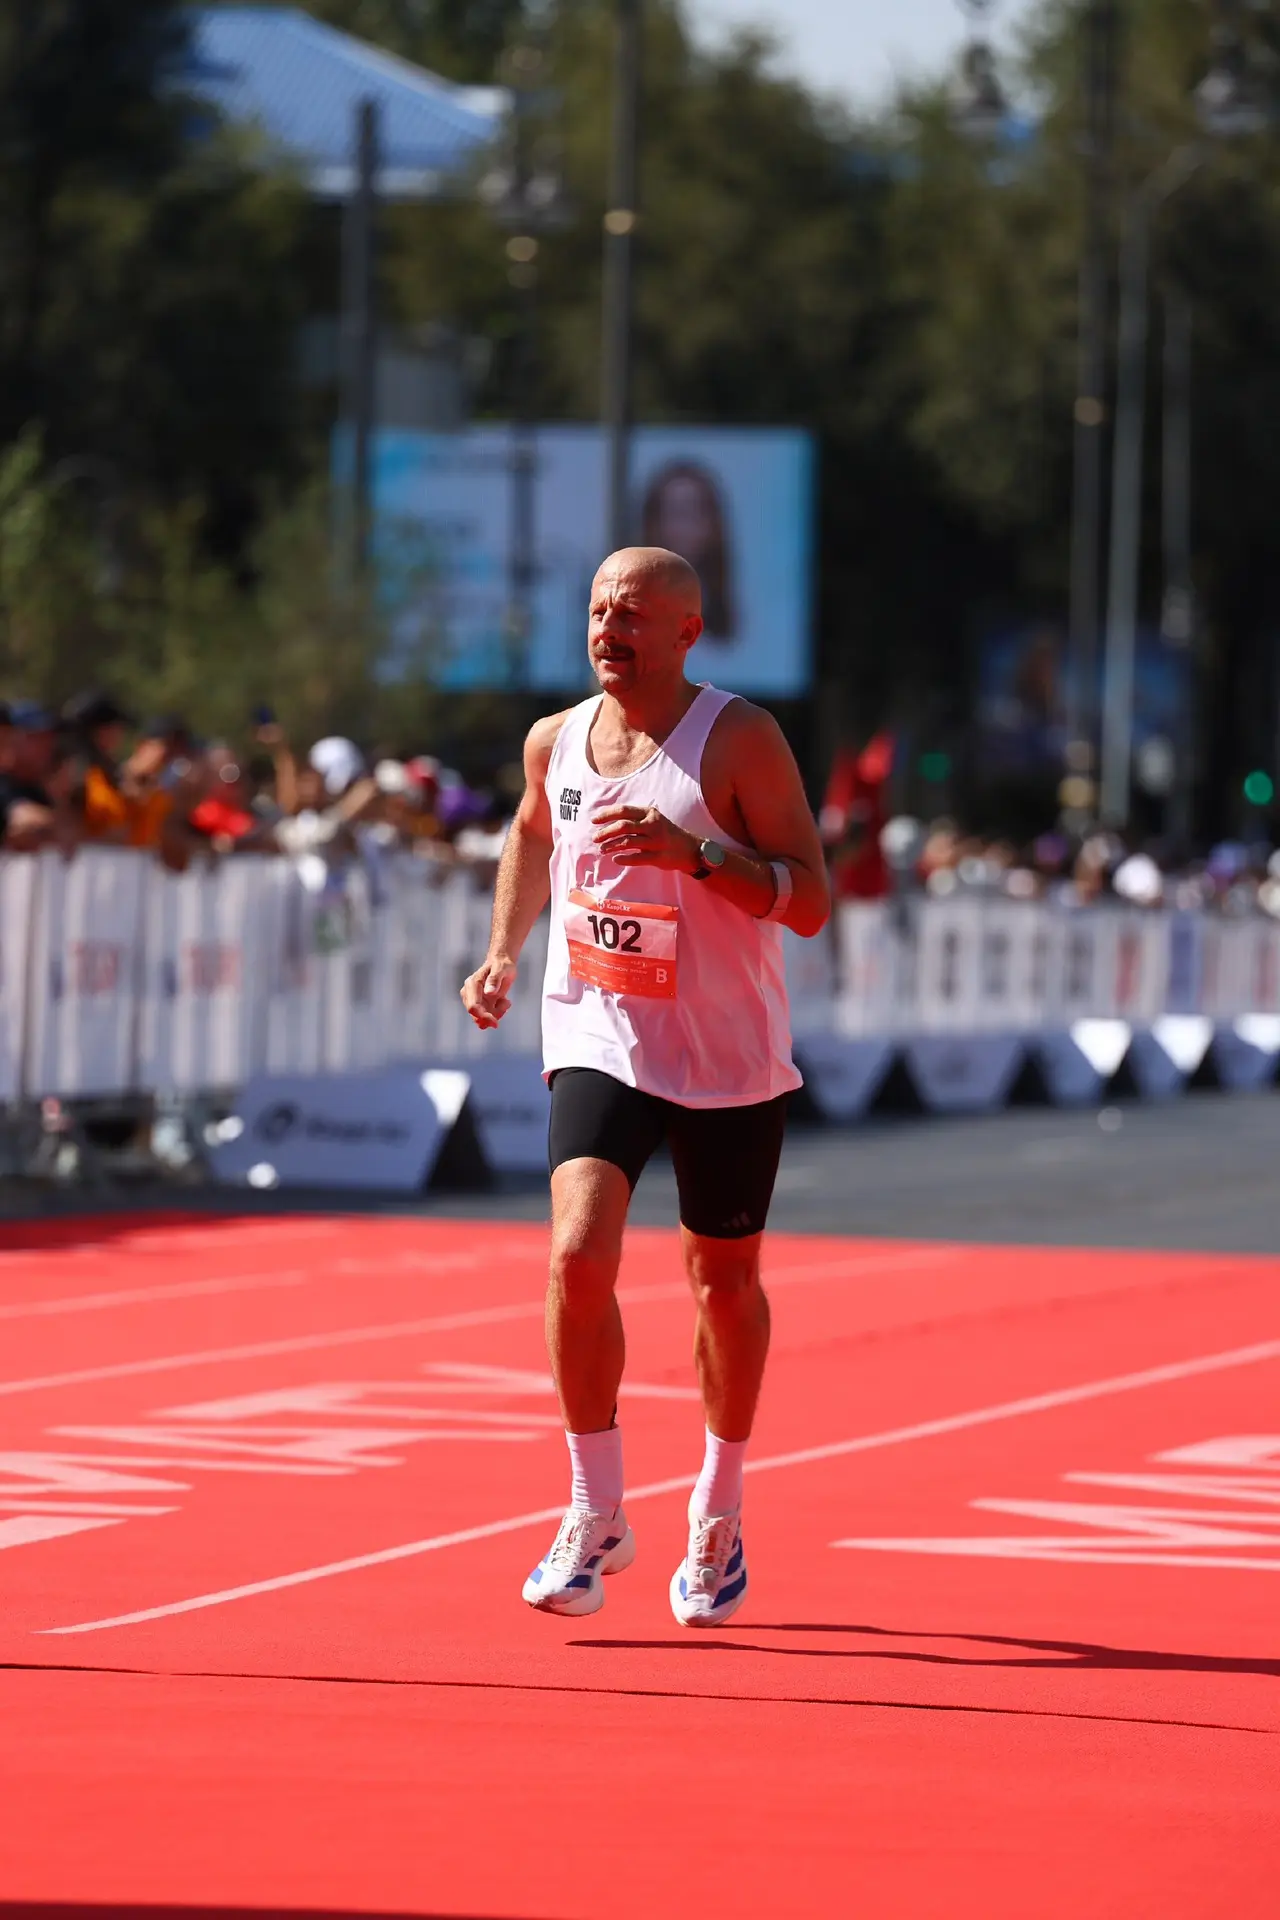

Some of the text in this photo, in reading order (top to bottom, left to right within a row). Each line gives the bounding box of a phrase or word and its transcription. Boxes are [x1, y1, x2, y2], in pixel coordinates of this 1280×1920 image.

[560, 788, 582, 805] JESUS
[560, 804, 573, 821] RUN
[588, 914, 642, 953] 102
[656, 968, 668, 983] B
